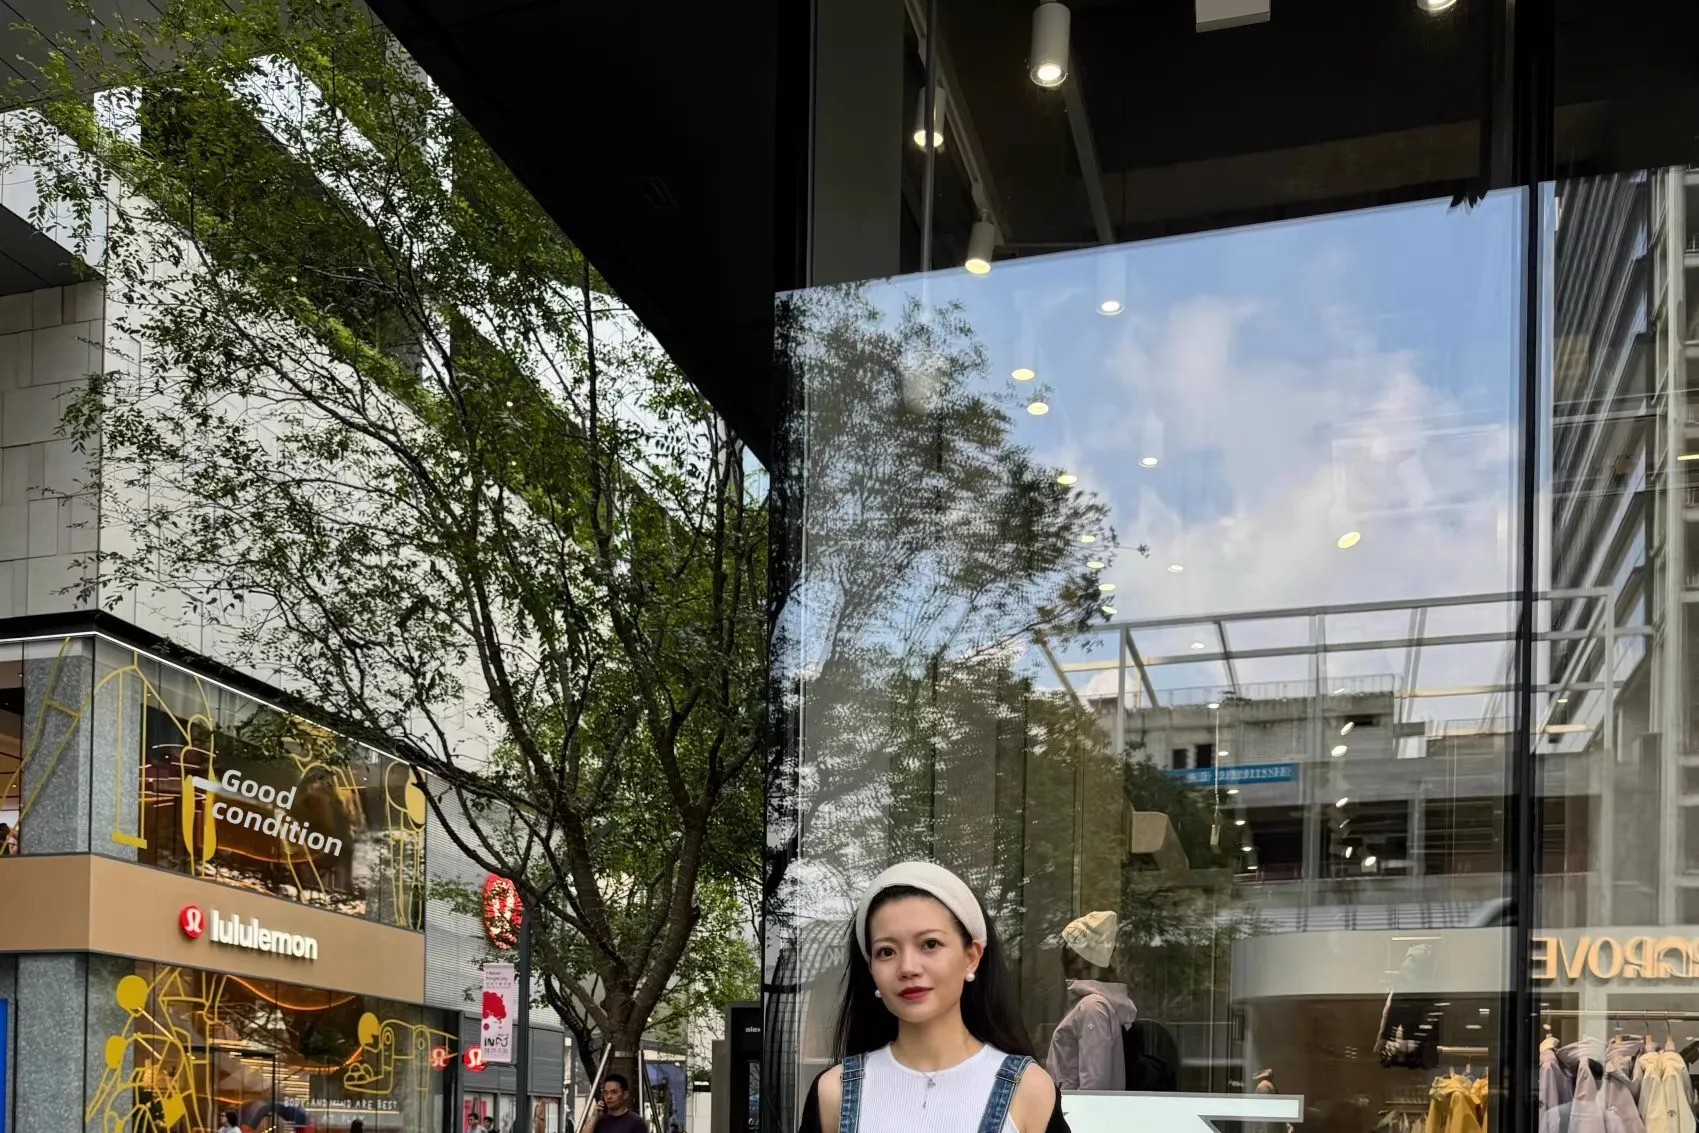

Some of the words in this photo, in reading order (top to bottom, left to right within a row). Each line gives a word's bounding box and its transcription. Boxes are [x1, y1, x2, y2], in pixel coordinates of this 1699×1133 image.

[221, 769, 297, 810] Good
[212, 801, 343, 857] condition
[210, 909, 318, 959] lululemon
[311, 1098, 327, 1107] AND
[354, 1099, 373, 1110] ARE
[377, 1099, 398, 1110] BEST
